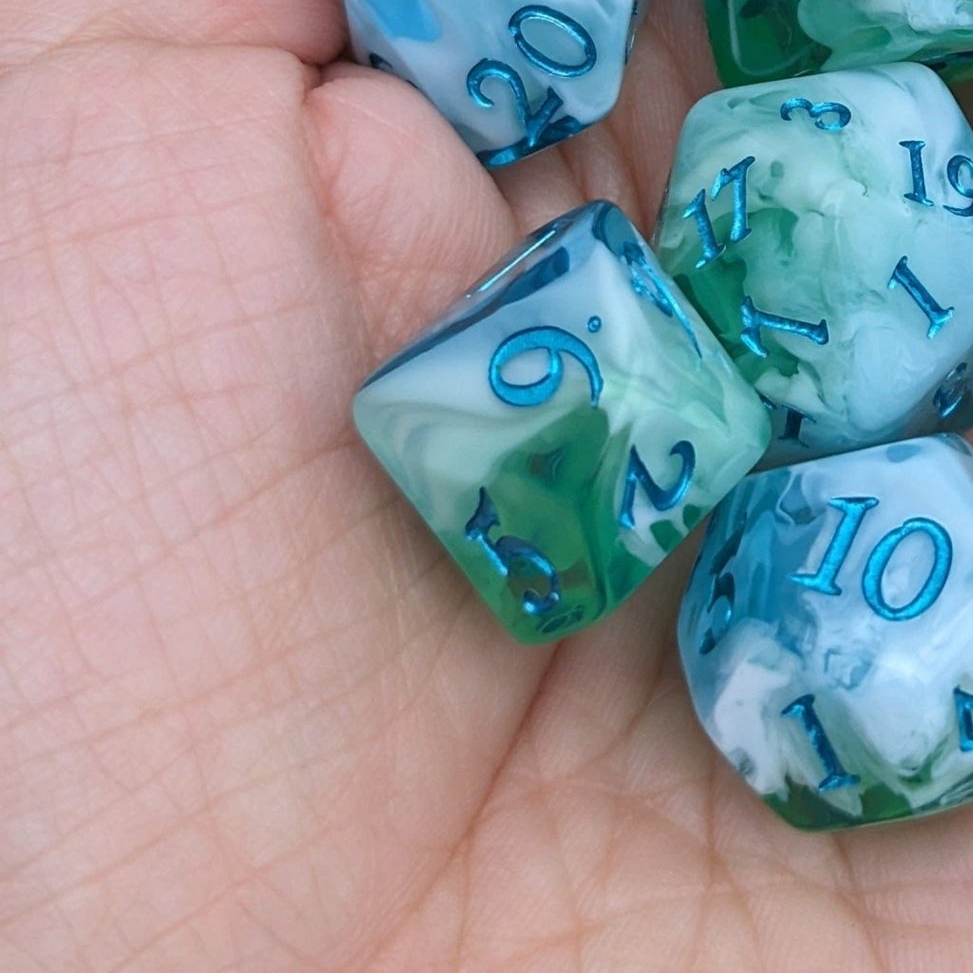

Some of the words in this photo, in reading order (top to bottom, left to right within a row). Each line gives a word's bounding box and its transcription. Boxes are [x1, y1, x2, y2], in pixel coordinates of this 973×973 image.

[780, 98, 852, 132] 3
[683, 155, 757, 269] 17
[888, 255, 955, 340] 1
[619, 440, 696, 530] 2
[464, 486, 561, 615] 5
[789, 495, 954, 622] 10
[781, 694, 862, 793] 1
